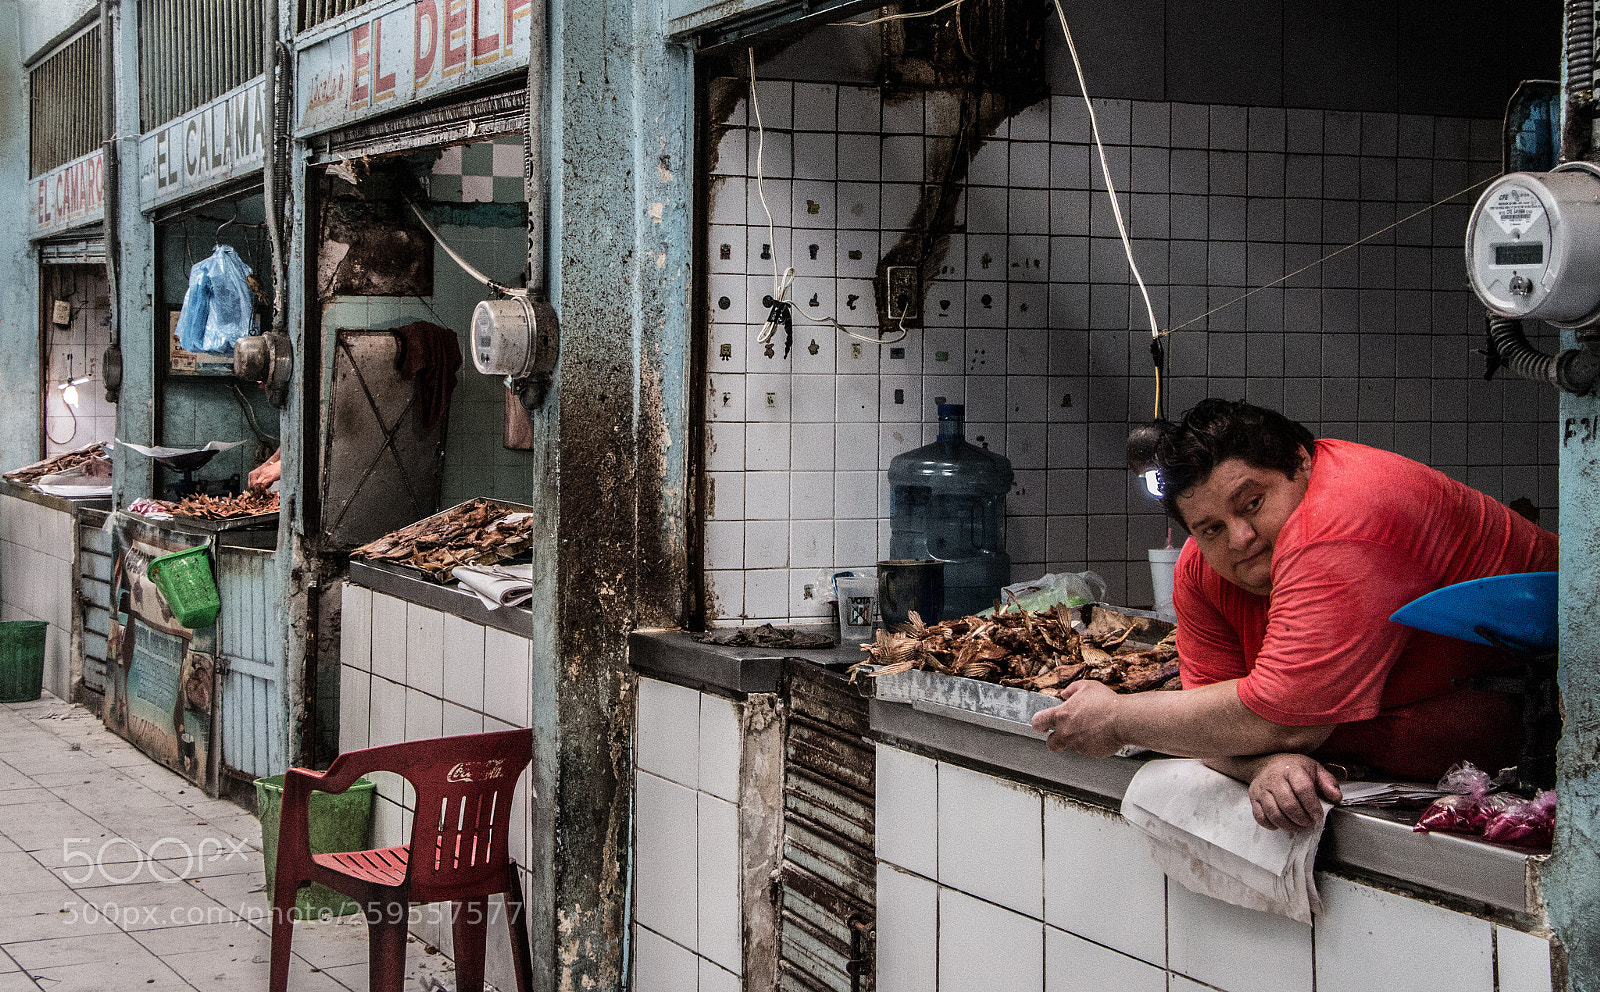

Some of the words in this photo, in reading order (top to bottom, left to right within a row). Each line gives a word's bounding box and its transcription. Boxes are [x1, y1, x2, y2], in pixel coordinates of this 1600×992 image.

[350, 18, 396, 108] EL
[157, 128, 178, 189] EL
[186, 82, 265, 178] CALAMA
[38, 176, 52, 225] EL
[56, 154, 104, 219] CAMARO
[851, 597, 871, 605] VOTA
[446, 758, 504, 783] Cocala
